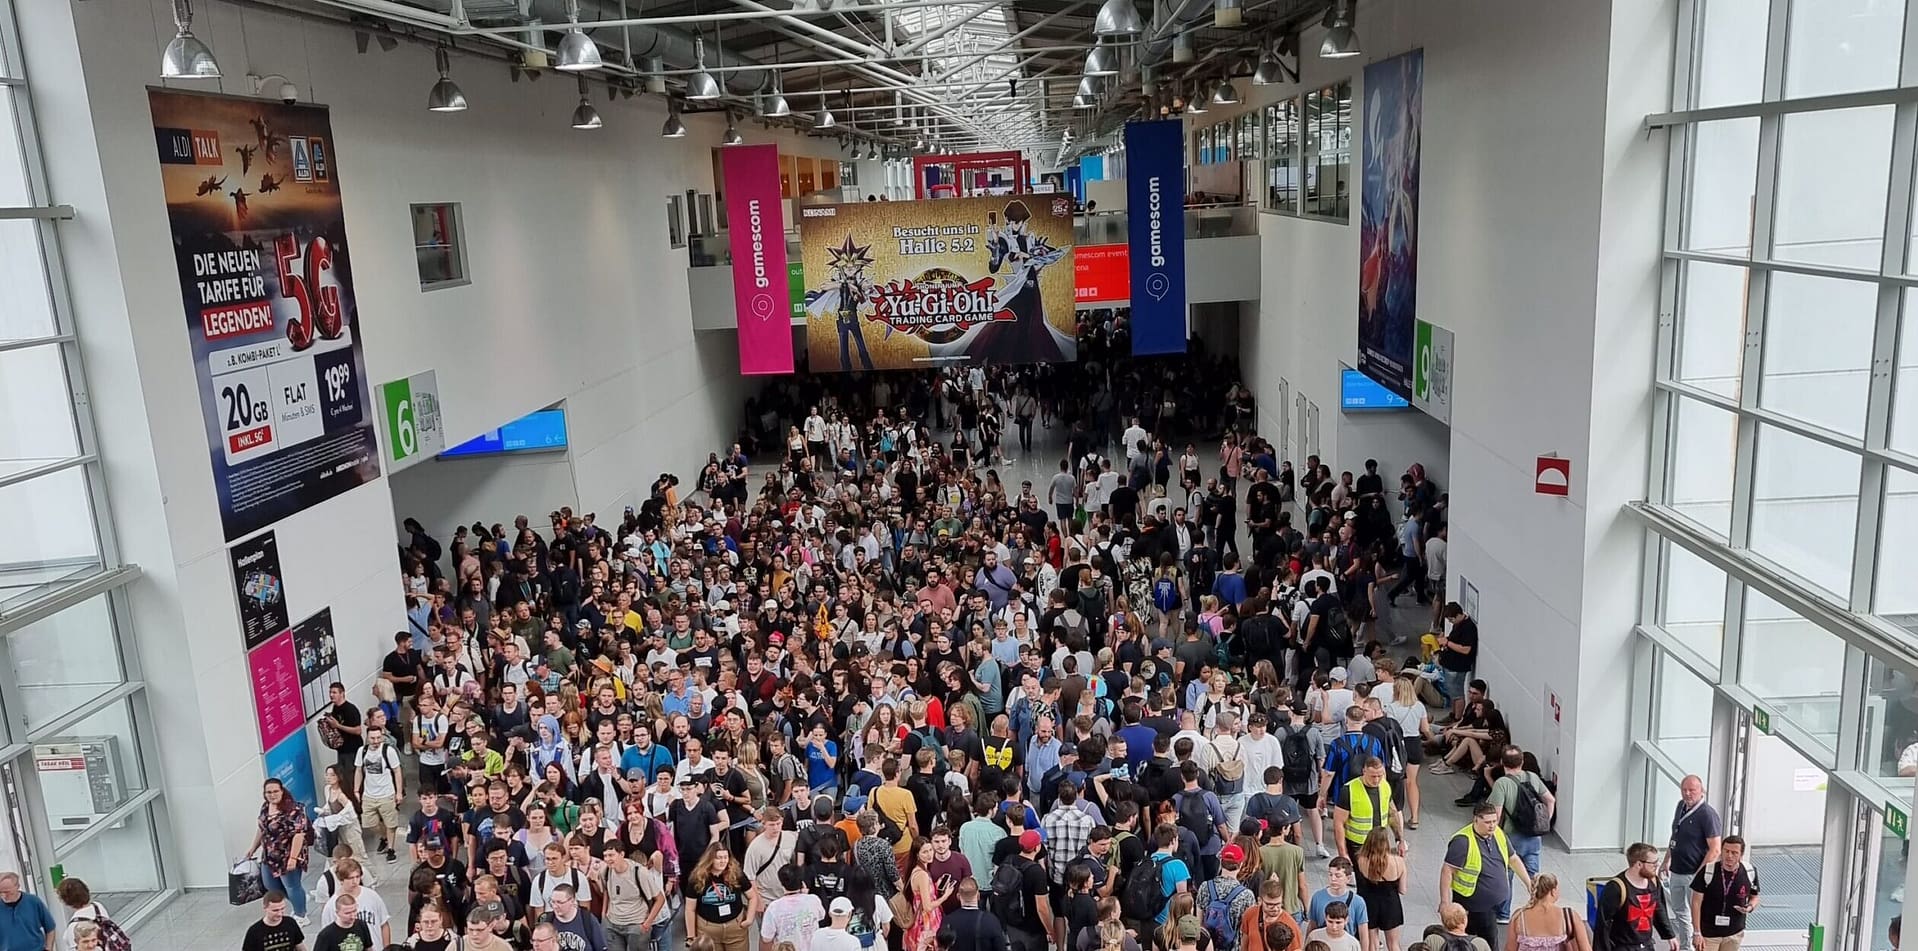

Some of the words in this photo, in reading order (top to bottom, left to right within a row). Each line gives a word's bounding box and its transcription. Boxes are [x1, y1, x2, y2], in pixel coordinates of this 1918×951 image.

[173, 135, 191, 158] ALDI
[195, 136, 219, 158] TALK
[893, 225, 939, 238] Besucht
[942, 226, 964, 236] uns
[967, 224, 978, 234] in
[1149, 176, 1165, 267] gamescom
[749, 199, 769, 288] gamescom
[899, 237, 946, 255] Halle
[951, 238, 975, 253] 5.2
[1107, 250, 1128, 258] event
[194, 253, 217, 276] DIE
[218, 249, 260, 274] NEUEN
[197, 278, 241, 304] TARIFE
[242, 272, 265, 298] FÜR
[274, 232, 343, 350] 5G
[203, 305, 273, 337] LEGENDEN!
[890, 316, 932, 325] TRADING
[935, 314, 962, 323] CARD
[964, 312, 994, 321] GAME
[238, 347, 276, 364] KOMBI-PAKET
[1421, 344, 1430, 400] 9
[284, 383, 306, 405] FLAT
[1386, 394, 1393, 404] 9
[222, 383, 252, 431] 20
[253, 401, 269, 423] GB
[397, 399, 416, 456] 6
[237, 434, 254, 448] INKL.
[545, 435, 552, 444] 6
